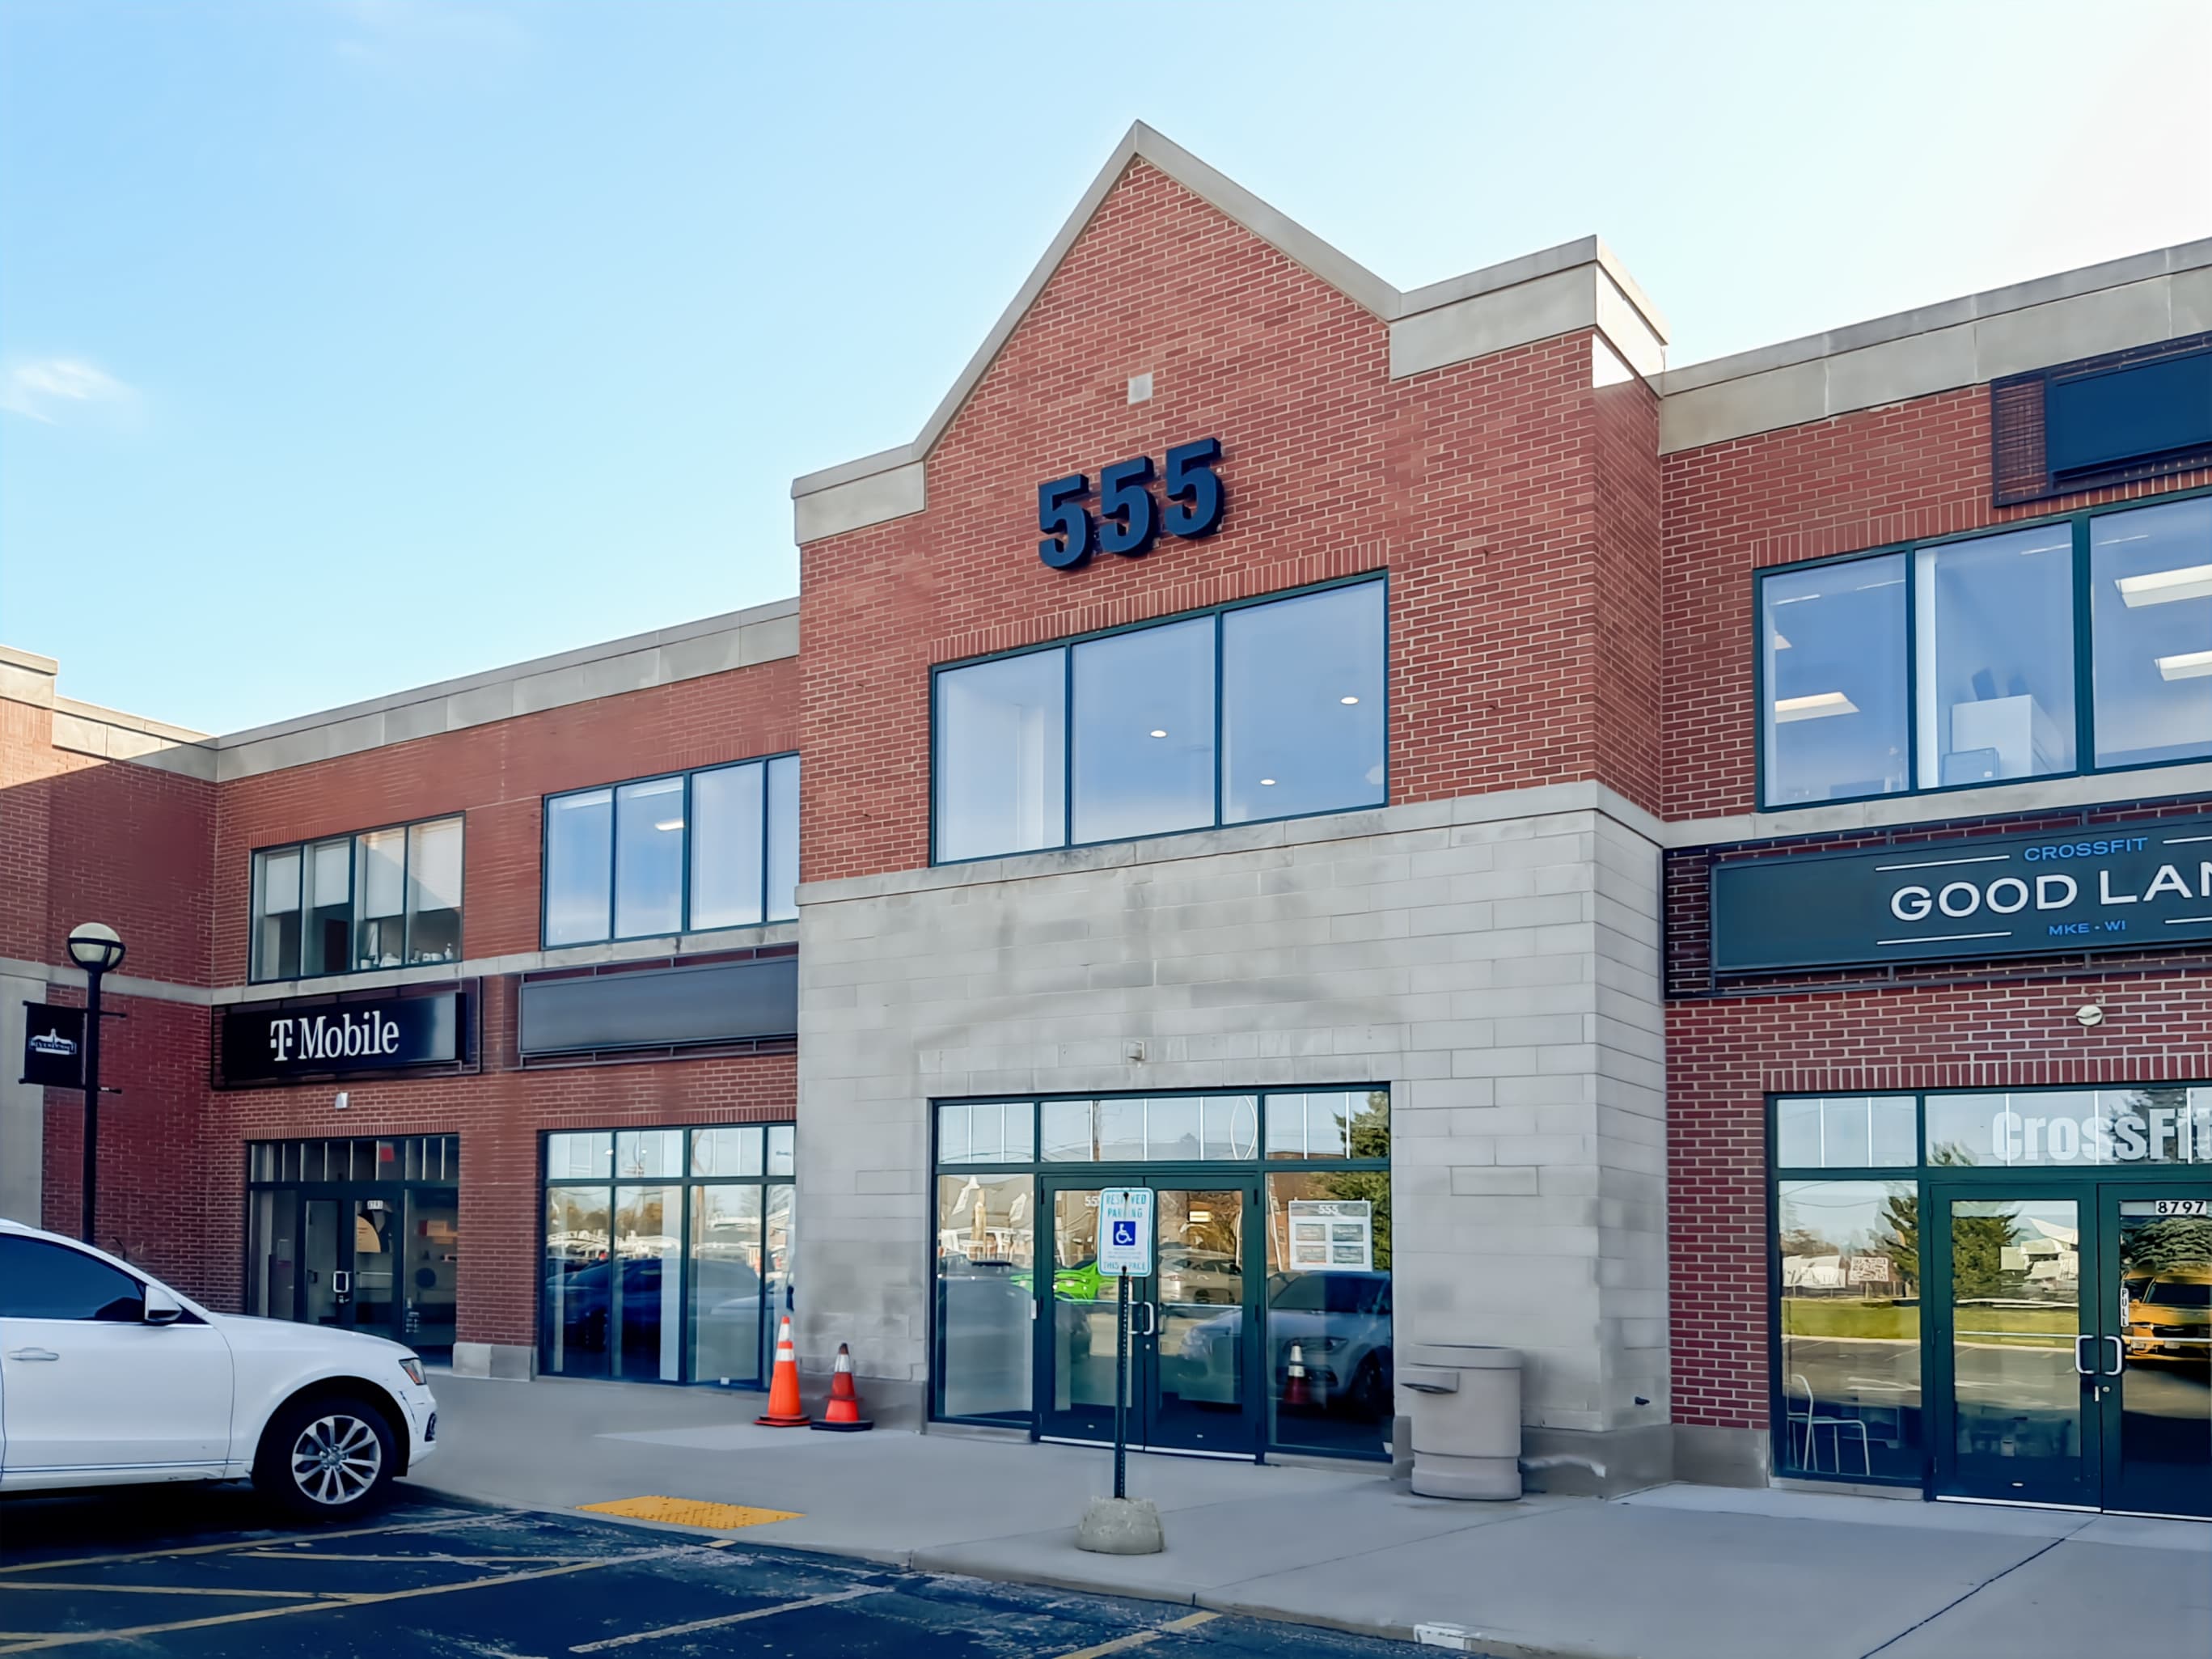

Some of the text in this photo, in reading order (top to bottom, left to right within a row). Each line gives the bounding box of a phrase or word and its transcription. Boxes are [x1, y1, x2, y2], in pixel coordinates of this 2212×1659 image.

[1038, 437, 1224, 570] 555
[2024, 837, 2148, 861] CROSSFIT
[1891, 874, 2078, 921] GOOD
[2049, 923, 2090, 936] MKE
[2104, 920, 2125, 931] WI
[298, 1010, 400, 1060] Mobile
[1318, 1204, 1339, 1214] 555
[2158, 1201, 2204, 1213] 8797
